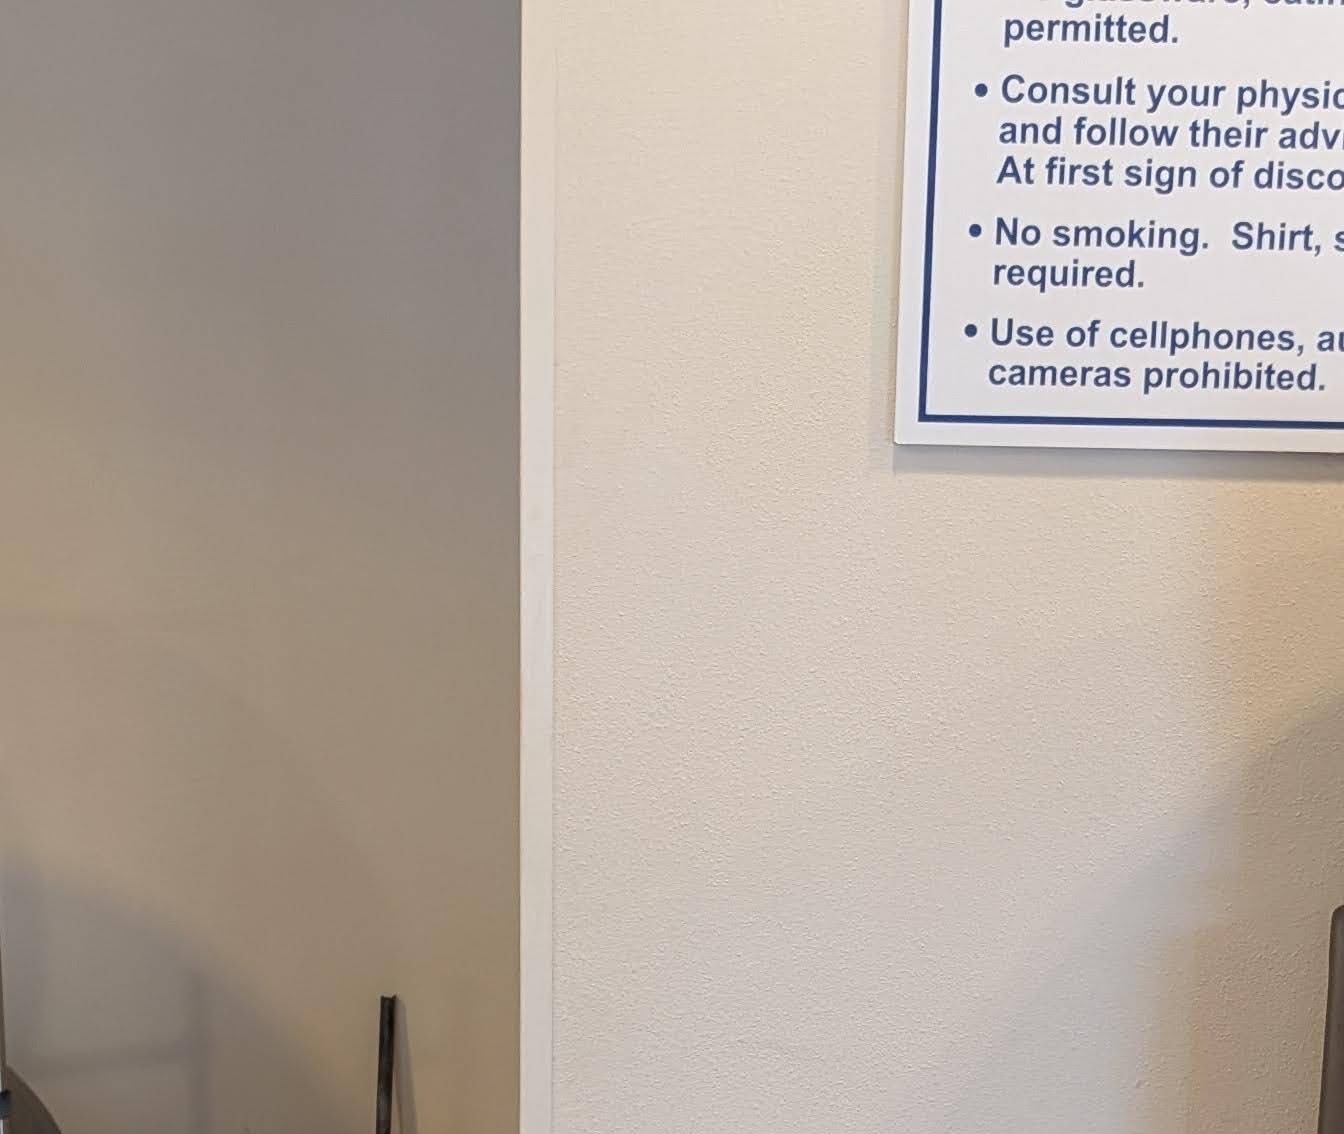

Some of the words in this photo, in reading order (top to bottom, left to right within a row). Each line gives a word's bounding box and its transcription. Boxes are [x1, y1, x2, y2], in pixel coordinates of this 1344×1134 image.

[1004, 12, 1178, 48] permitted.
[1001, 73, 1136, 106] Consult
[1146, 84, 1227, 114] your
[998, 115, 1062, 145] and
[1073, 116, 1179, 147] follow
[1188, 118, 1269, 149] their
[996, 155, 1035, 185] At
[1044, 156, 1114, 187] first
[1124, 158, 1197, 195] sign
[1209, 159, 1245, 189] of
[995, 216, 1041, 246] No
[1052, 219, 1209, 257] smoking.
[1231, 221, 1321, 257] Shirt,
[993, 258, 1144, 294] required.
[991, 317, 1054, 347] Use
[1066, 319, 1102, 348] of
[1109, 320, 1304, 357] cellphones,
[988, 364, 1131, 388] cameras
[1143, 361, 1325, 395] prohibited.
